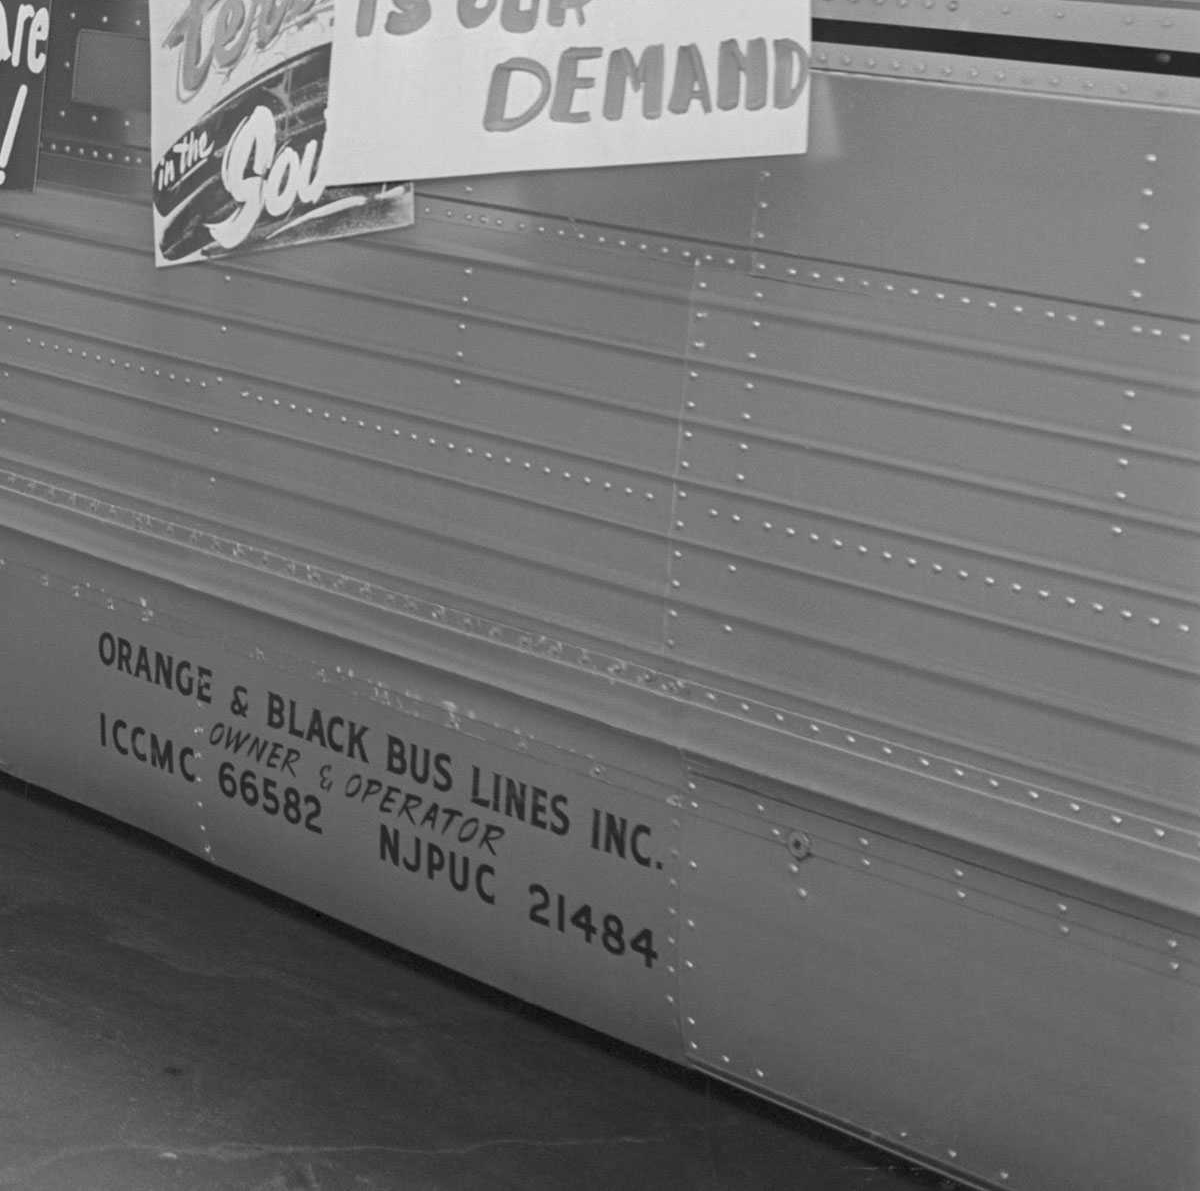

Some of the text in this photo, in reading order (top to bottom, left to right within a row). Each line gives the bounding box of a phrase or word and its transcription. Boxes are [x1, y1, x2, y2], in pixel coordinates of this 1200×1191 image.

[482, 36, 811, 133] DEMAND
[155, 130, 215, 191] in the
[98, 631, 664, 871] ORANGE & BLACK BUS LINES INC.
[208, 721, 506, 857] OWNER & OPERATOR
[217, 761, 324, 835] 66582
[379, 822, 659, 969] NJPUC 21484
